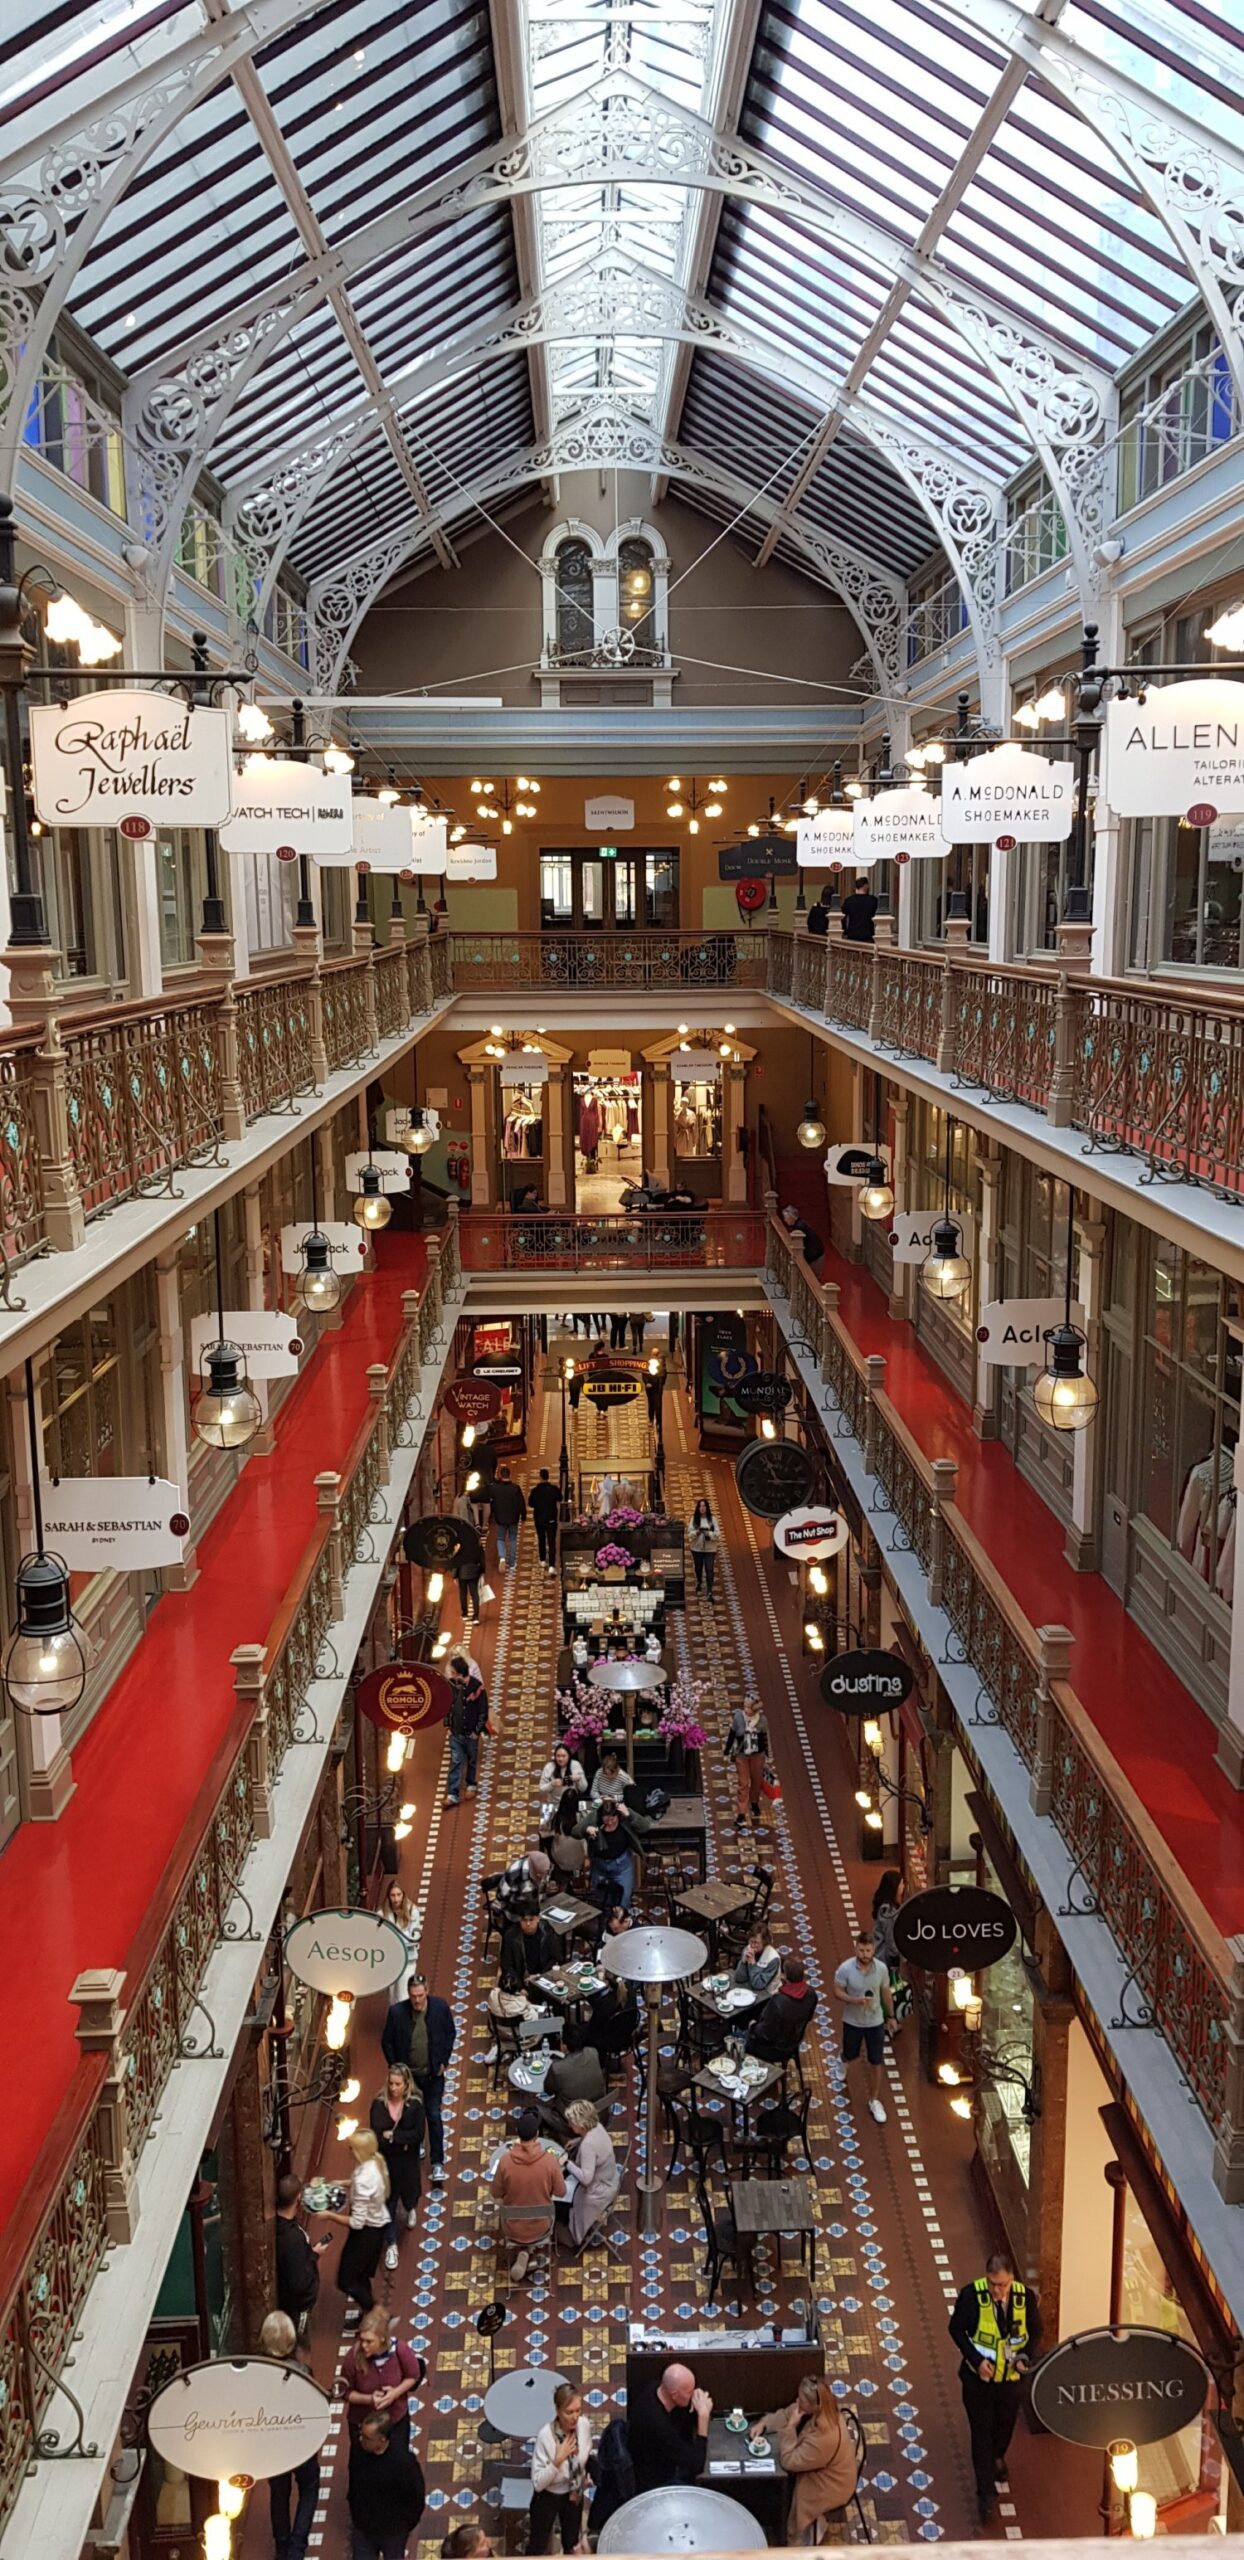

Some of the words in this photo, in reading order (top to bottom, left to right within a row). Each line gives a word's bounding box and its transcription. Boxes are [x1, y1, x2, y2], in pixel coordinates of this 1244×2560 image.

[1125, 723, 1238, 751] ALLEN
[55, 715, 192, 774] Raphaël
[1193, 759, 1244, 770] TAILORI
[55, 757, 197, 814] Jewellers
[276, 807, 310, 819] TECH
[964, 809, 1050, 822] SHOEMAKER
[1193, 810, 1212, 821] 119
[125, 822, 146, 833] 118
[870, 833, 936, 843] SHOEMAKER
[999, 839, 1014, 848] 121
[278, 849, 294, 858] 120
[896, 854, 909, 862] 123
[237, 1343, 284, 1352] SEBASTIAN
[291, 1343, 300, 1351] 70
[578, 1361, 597, 1371] LIFT
[608, 1359, 648, 1369] SHOPPING
[588, 1383, 606, 1393] JB
[451, 1386, 491, 1402] VINTAGE
[44, 1521, 85, 1532] SARAH
[86, 1521, 96, 1532] &
[97, 1520, 162, 1531] SEBASTIAN
[173, 1519, 186, 1528] 70
[788, 1531, 803, 1541] The
[803, 1528, 816, 1538] Nut
[816, 1526, 835, 1536] Shop
[830, 1673, 903, 1694] dustins
[386, 1696, 425, 1704] ROMOLO
[942, 1922, 1005, 1939] LOVES
[952, 1970, 961, 1978] 21
[340, 1992, 351, 2001] 20
[1057, 2379, 1184, 2405] NIESSING
[1114, 2444, 1129, 2454] 19
[235, 2476, 250, 2487] 22
